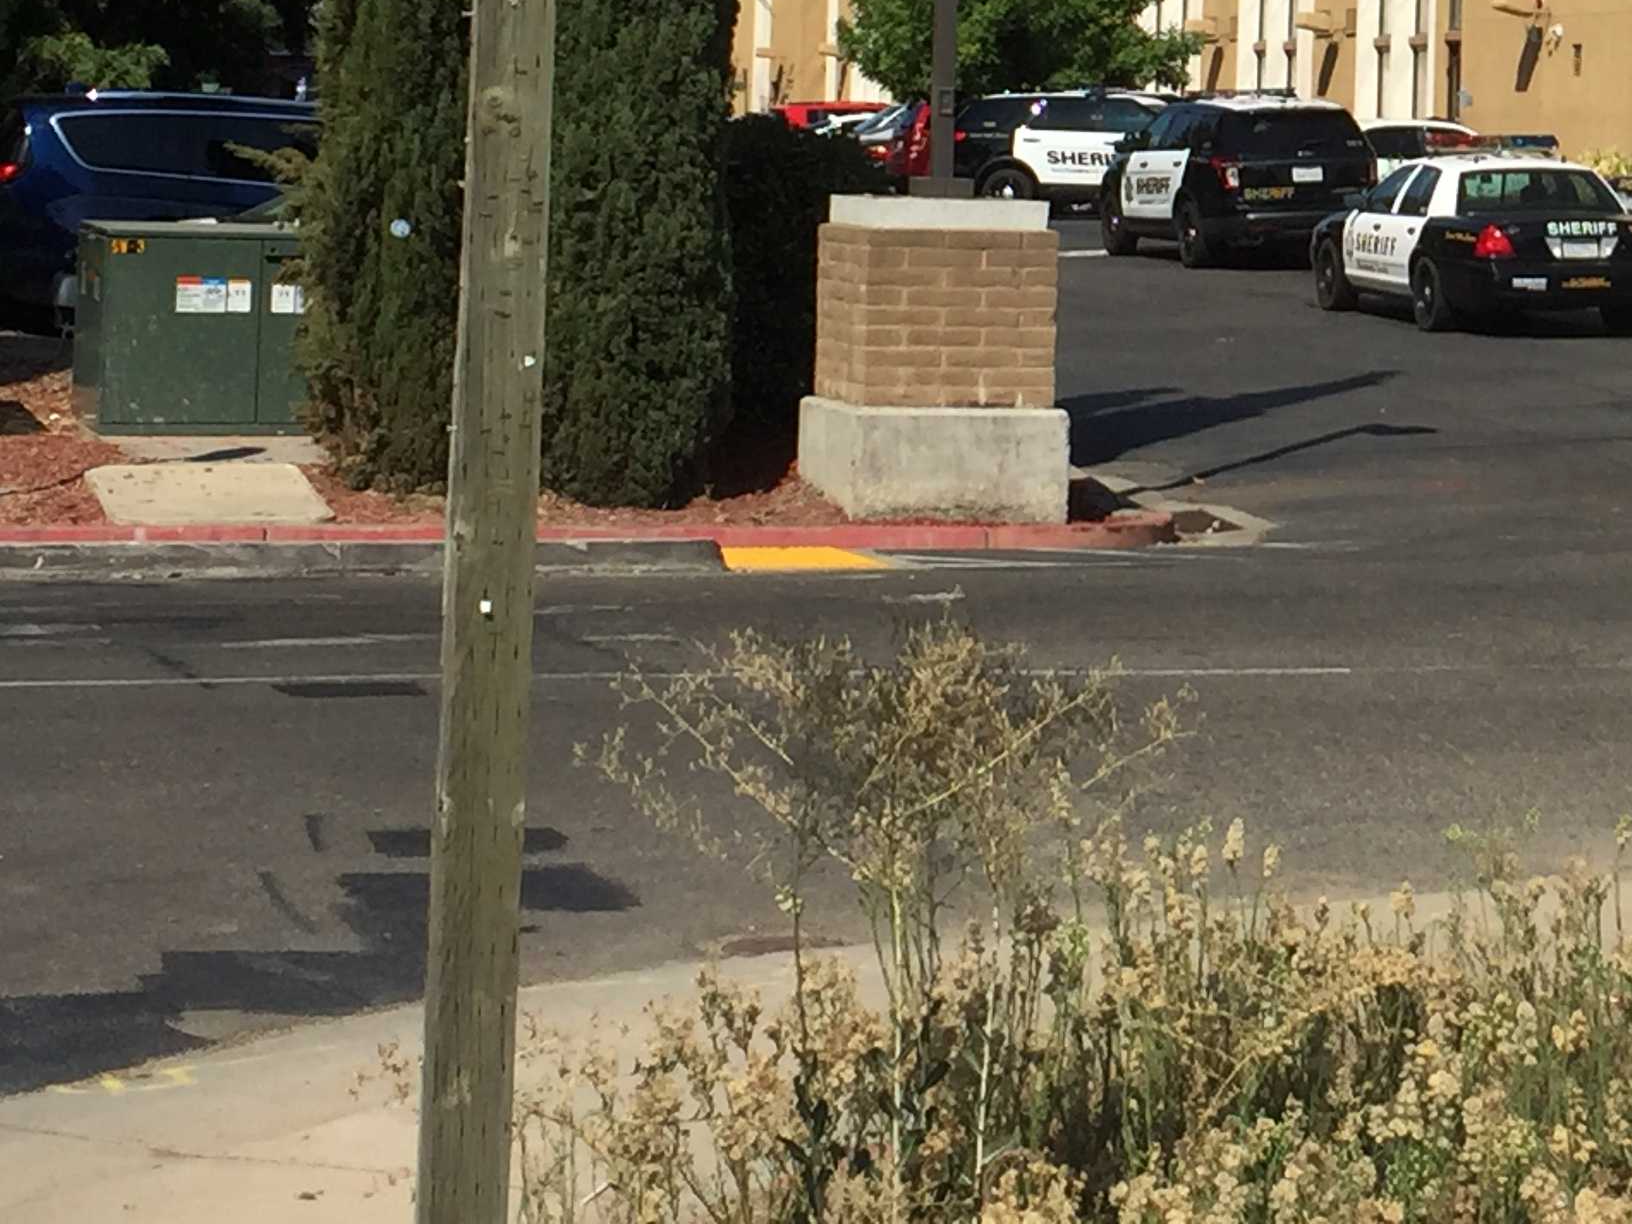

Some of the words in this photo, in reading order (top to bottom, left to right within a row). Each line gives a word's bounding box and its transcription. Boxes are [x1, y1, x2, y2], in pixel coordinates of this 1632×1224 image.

[1136, 177, 1171, 194] SHERIFF
[1244, 187, 1295, 201] SHERIFF
[1547, 222, 1617, 237] SHERIFF
[1356, 232, 1398, 256] SHERIFF
